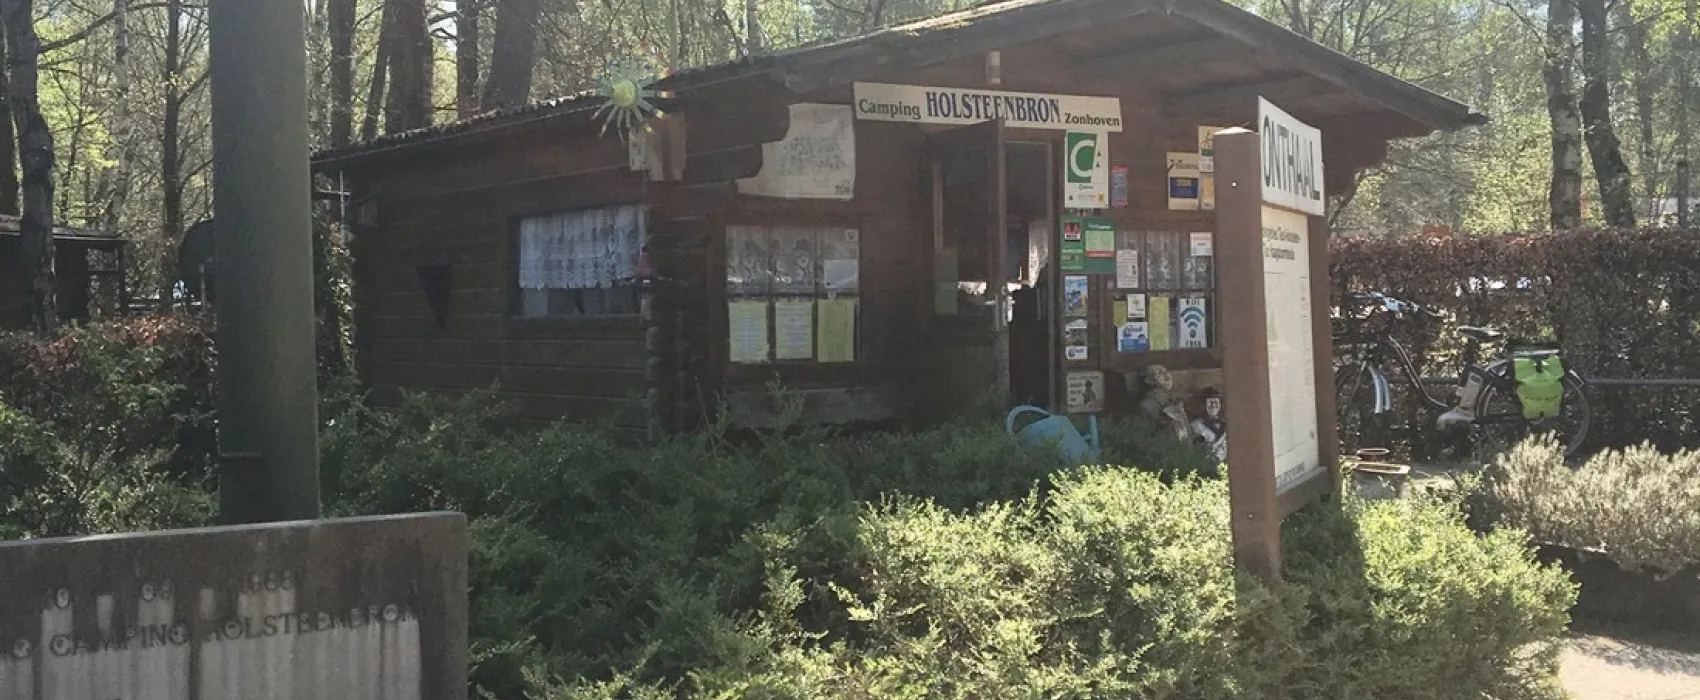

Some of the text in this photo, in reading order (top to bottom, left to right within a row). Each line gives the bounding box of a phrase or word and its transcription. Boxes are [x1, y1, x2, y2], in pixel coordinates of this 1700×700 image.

[858, 91, 1121, 127] Camping HOLSTEENBRON Zonhoven
[1262, 114, 1321, 201] ONTHAAL
[50, 622, 191, 657] CAMPING
